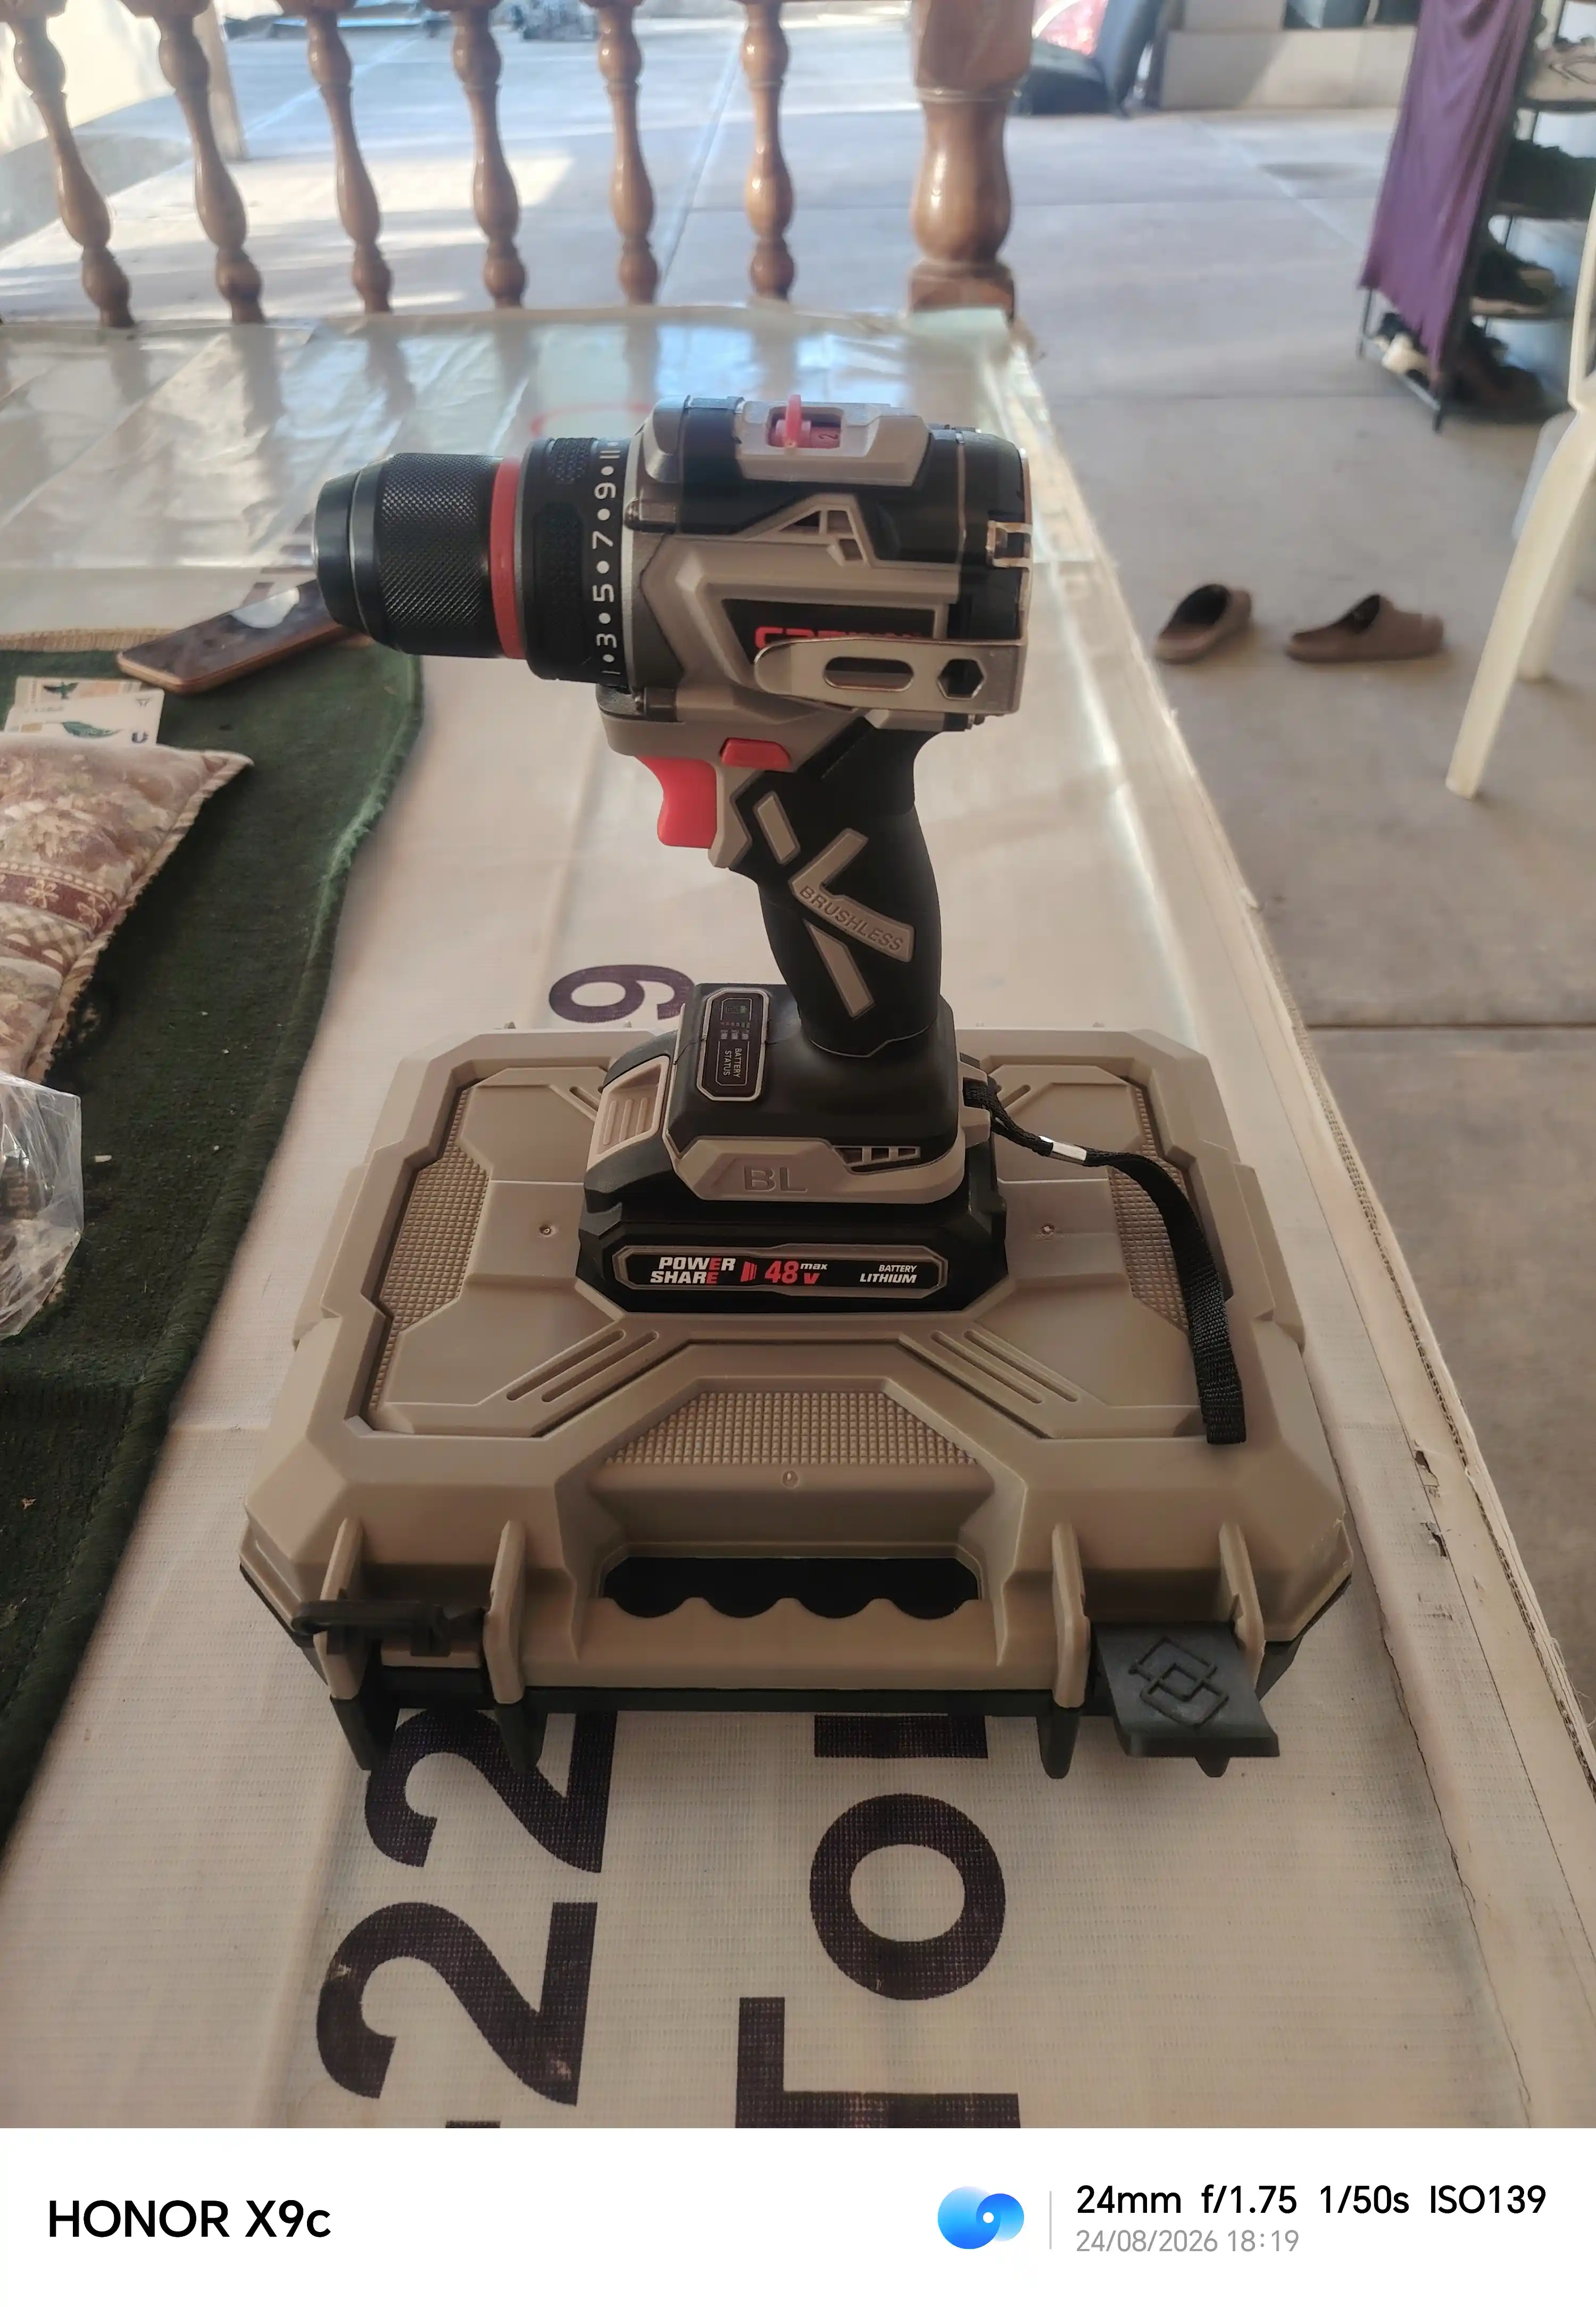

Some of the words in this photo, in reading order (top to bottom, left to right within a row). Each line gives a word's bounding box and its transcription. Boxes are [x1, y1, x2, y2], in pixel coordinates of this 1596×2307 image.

[594, 482, 617, 500] 9
[592, 530, 614, 550] 7
[592, 583, 614, 603] 5
[596, 633, 617, 649] 3
[799, 885, 903, 951] BRUSHLESS
[722, 1050, 732, 1076] STATUS
[733, 1048, 742, 1078] BATTERY
[743, 1166, 808, 1192] BL
[658, 1257, 736, 1271] POWER
[764, 1260, 799, 1284] 48
[878, 1264, 917, 1273] BATTERY
[650, 1271, 718, 1284] SHARE
[859, 1273, 917, 1283] LITHIUM
[317, 1709, 618, 2128] 22
